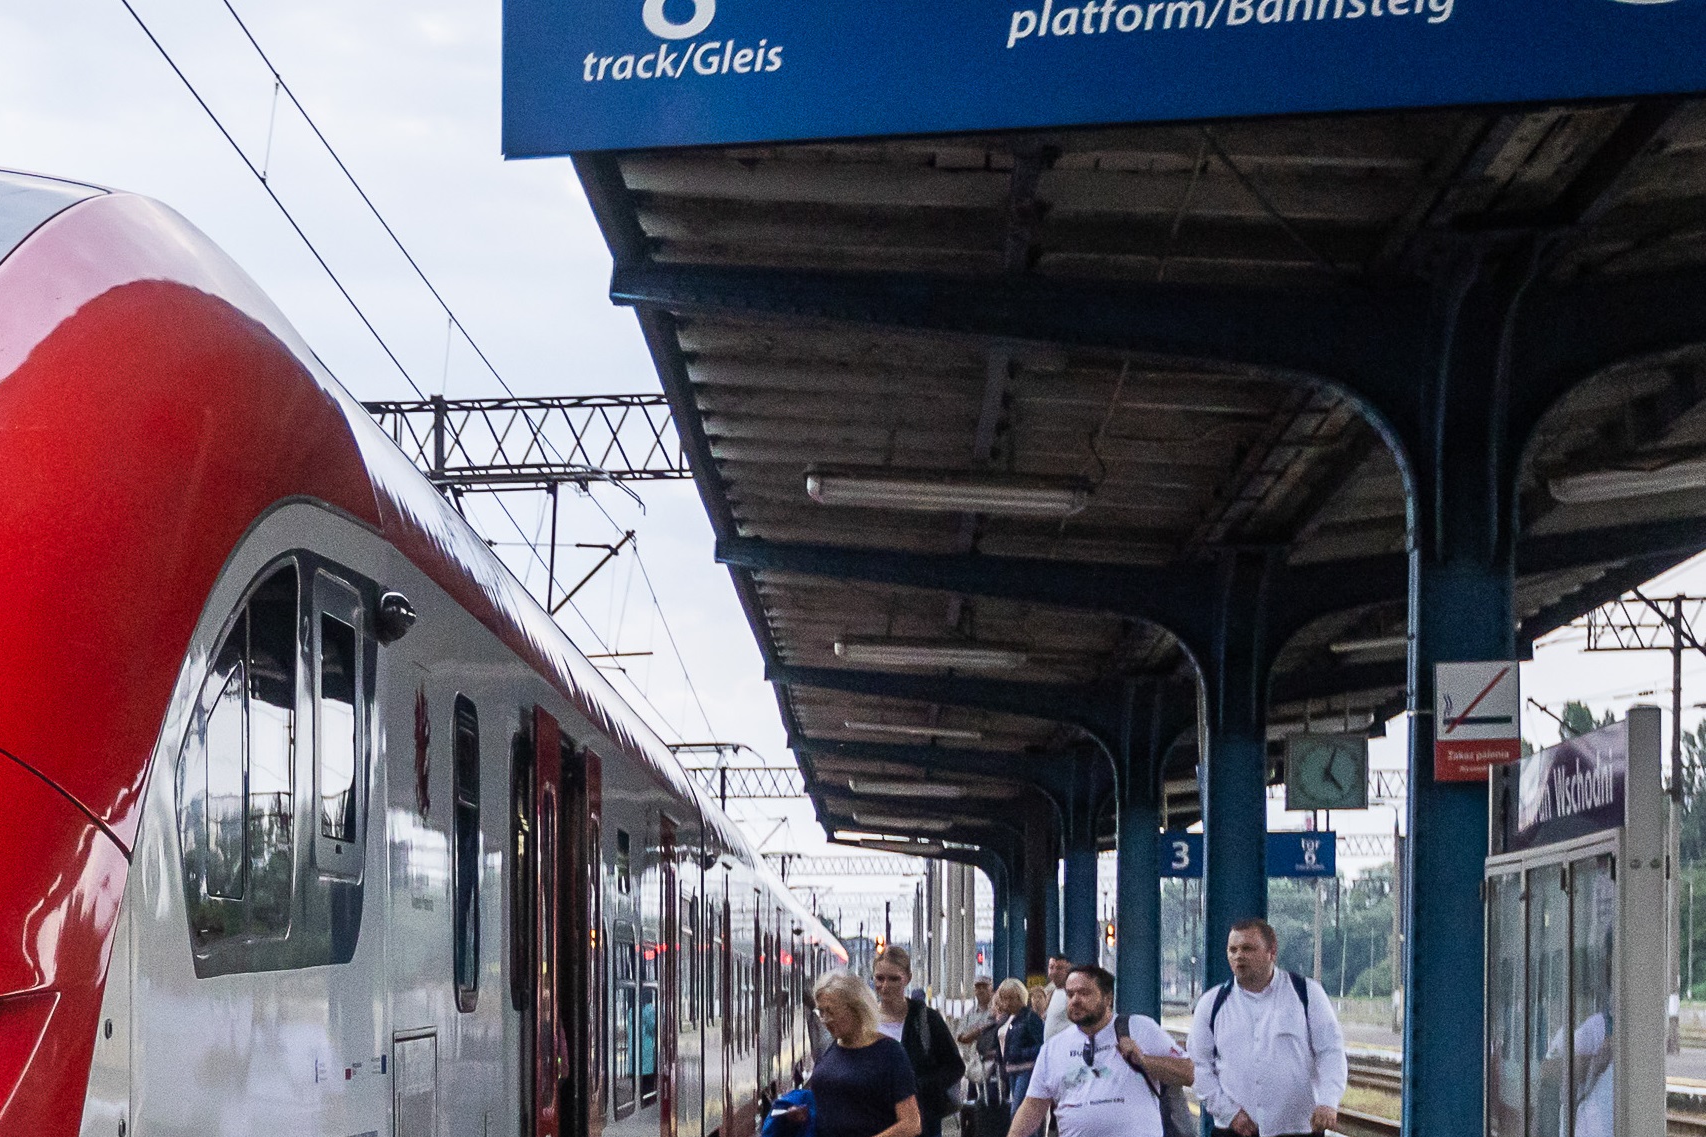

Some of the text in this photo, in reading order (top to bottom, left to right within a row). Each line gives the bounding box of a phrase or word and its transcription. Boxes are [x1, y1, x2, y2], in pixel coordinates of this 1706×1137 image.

[583, 39, 784, 82] track/Gleis
[1554, 747, 1612, 817] Wschodni
[1172, 841, 1190, 870] 3
